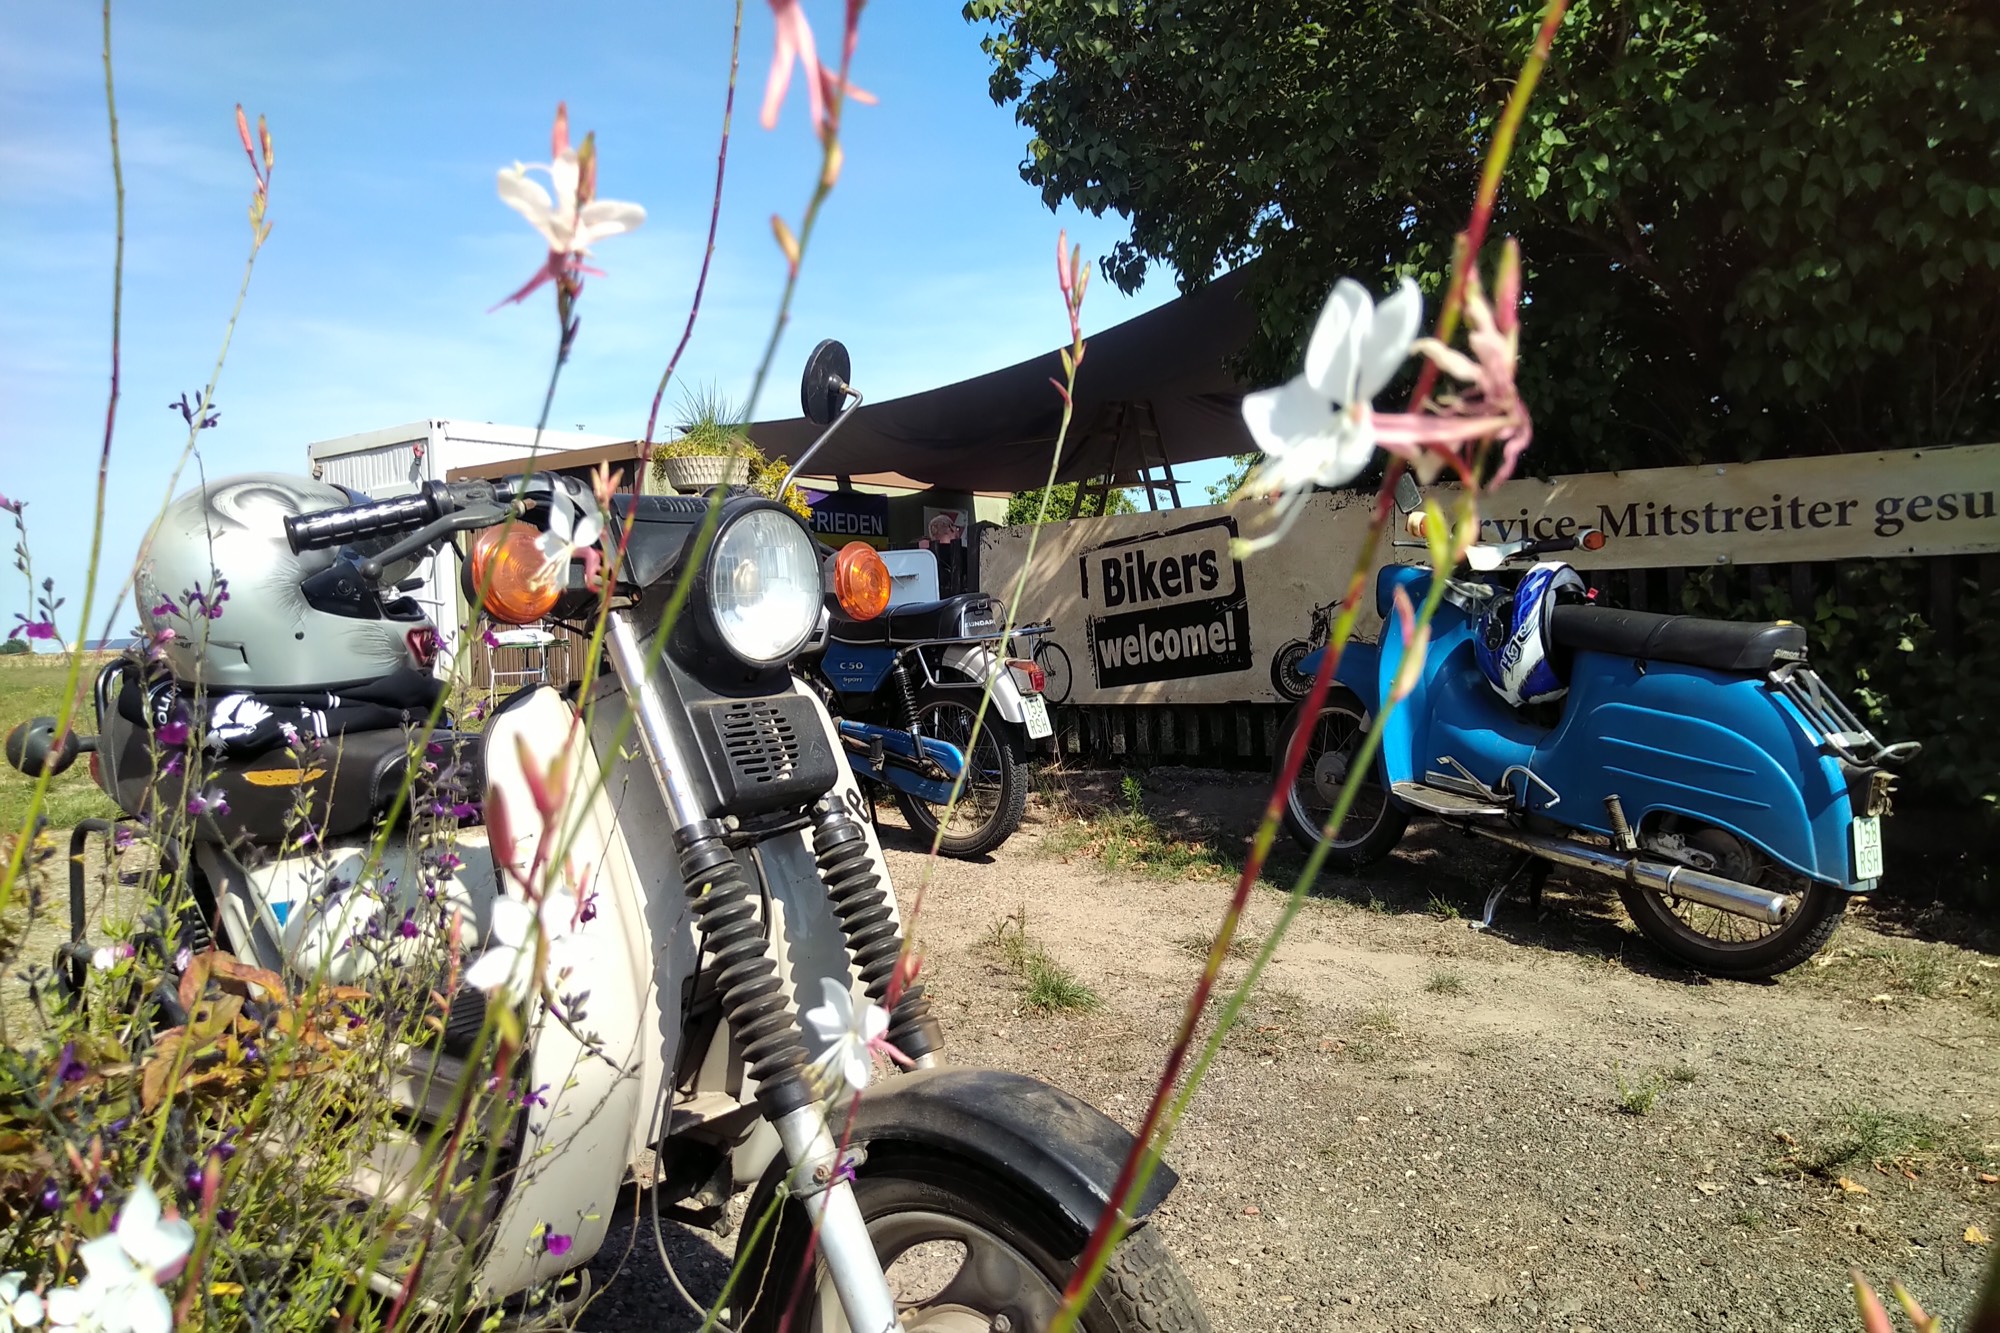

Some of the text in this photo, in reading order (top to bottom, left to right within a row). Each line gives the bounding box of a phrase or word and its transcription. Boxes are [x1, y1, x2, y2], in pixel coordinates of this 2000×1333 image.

[1874, 490, 1998, 537] gesu
[1101, 549, 1219, 608] Bikers
[1098, 610, 1237, 669] welcome!
[839, 661, 864, 670] C 50
[1030, 717, 1049, 735] RSH
[1858, 820, 1878, 846] 158
[1860, 848, 1880, 873] RSH
